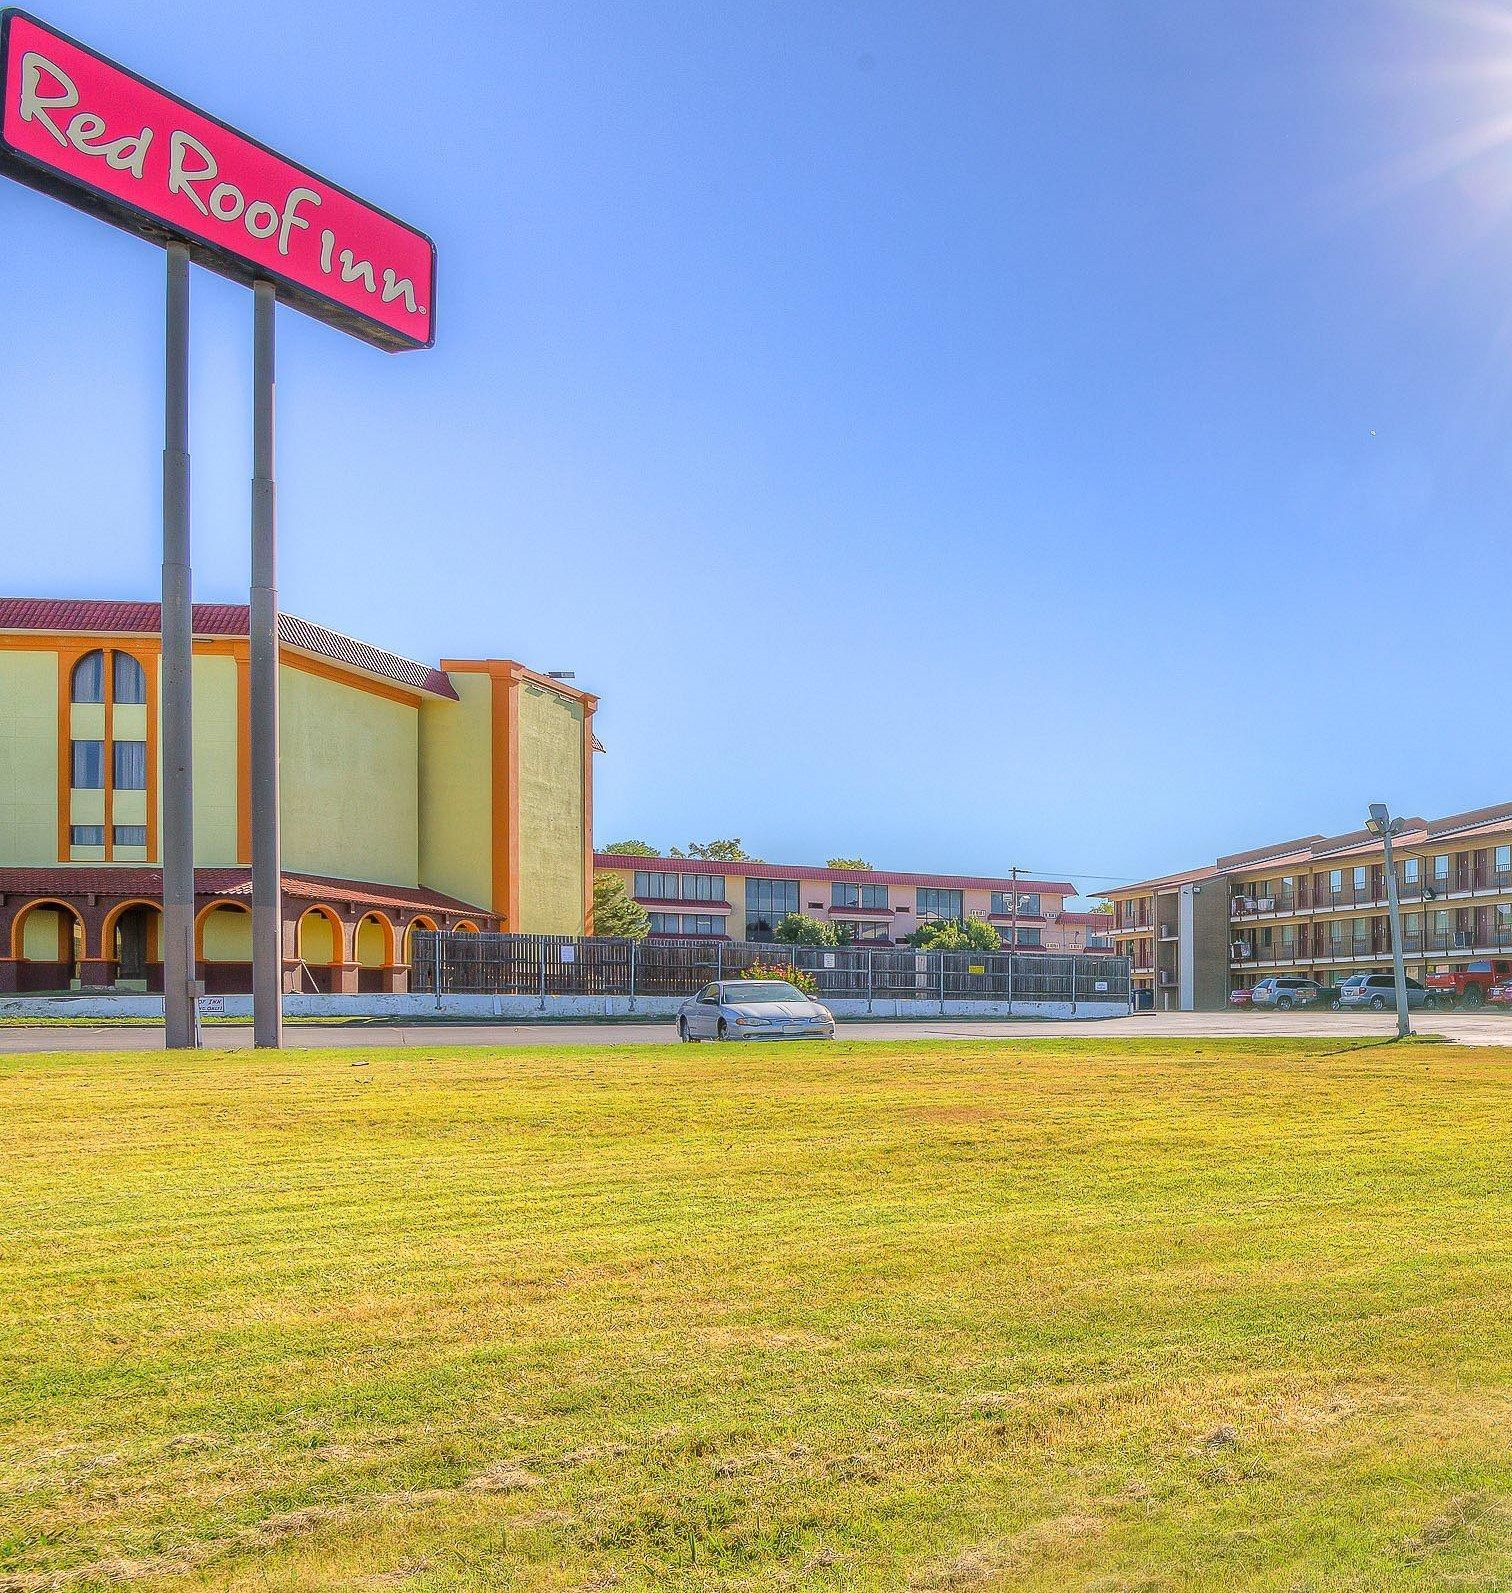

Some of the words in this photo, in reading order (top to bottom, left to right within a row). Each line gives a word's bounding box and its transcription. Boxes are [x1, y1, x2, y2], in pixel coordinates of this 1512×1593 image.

[20, 51, 154, 179] Red
[168, 130, 322, 255] Roof
[320, 229, 418, 313] Inn
